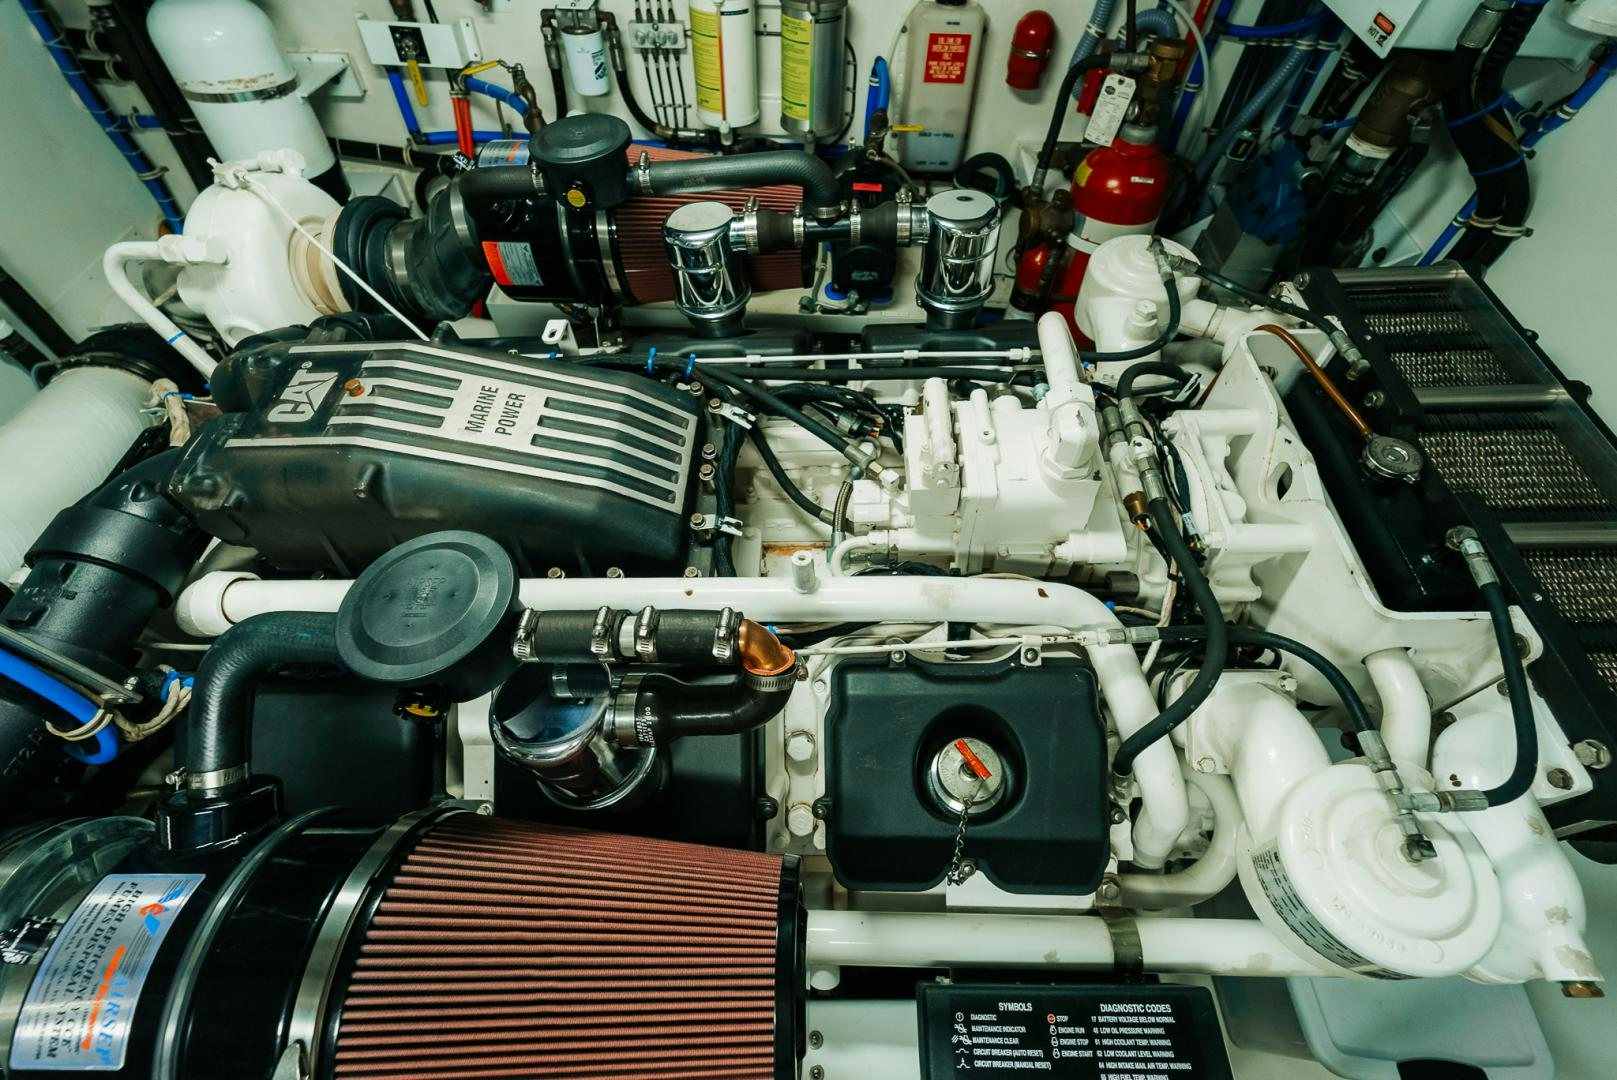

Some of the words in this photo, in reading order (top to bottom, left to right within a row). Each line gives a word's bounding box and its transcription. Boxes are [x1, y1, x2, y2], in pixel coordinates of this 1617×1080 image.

[267, 370, 338, 422] CAT
[464, 385, 499, 432] MARINE
[494, 392, 526, 436] POWER
[101, 881, 138, 925] FUMES
[117, 889, 143, 925] HIGH
[63, 927, 105, 998] DISPOSAL
[96, 974, 128, 1064] AIRSEP
[998, 1002, 1032, 1012] SYMBOLS
[1100, 1004, 1144, 1012] DIAGNOSTIC
[1146, 1004, 1172, 1012] CODES
[1013, 1050, 1026, 1058] (AUTO
[1027, 1050, 1044, 1058] RESET)
[1014, 1061, 1034, 1069] (MANUAL
[1034, 1062, 1052, 1070] RESET)
